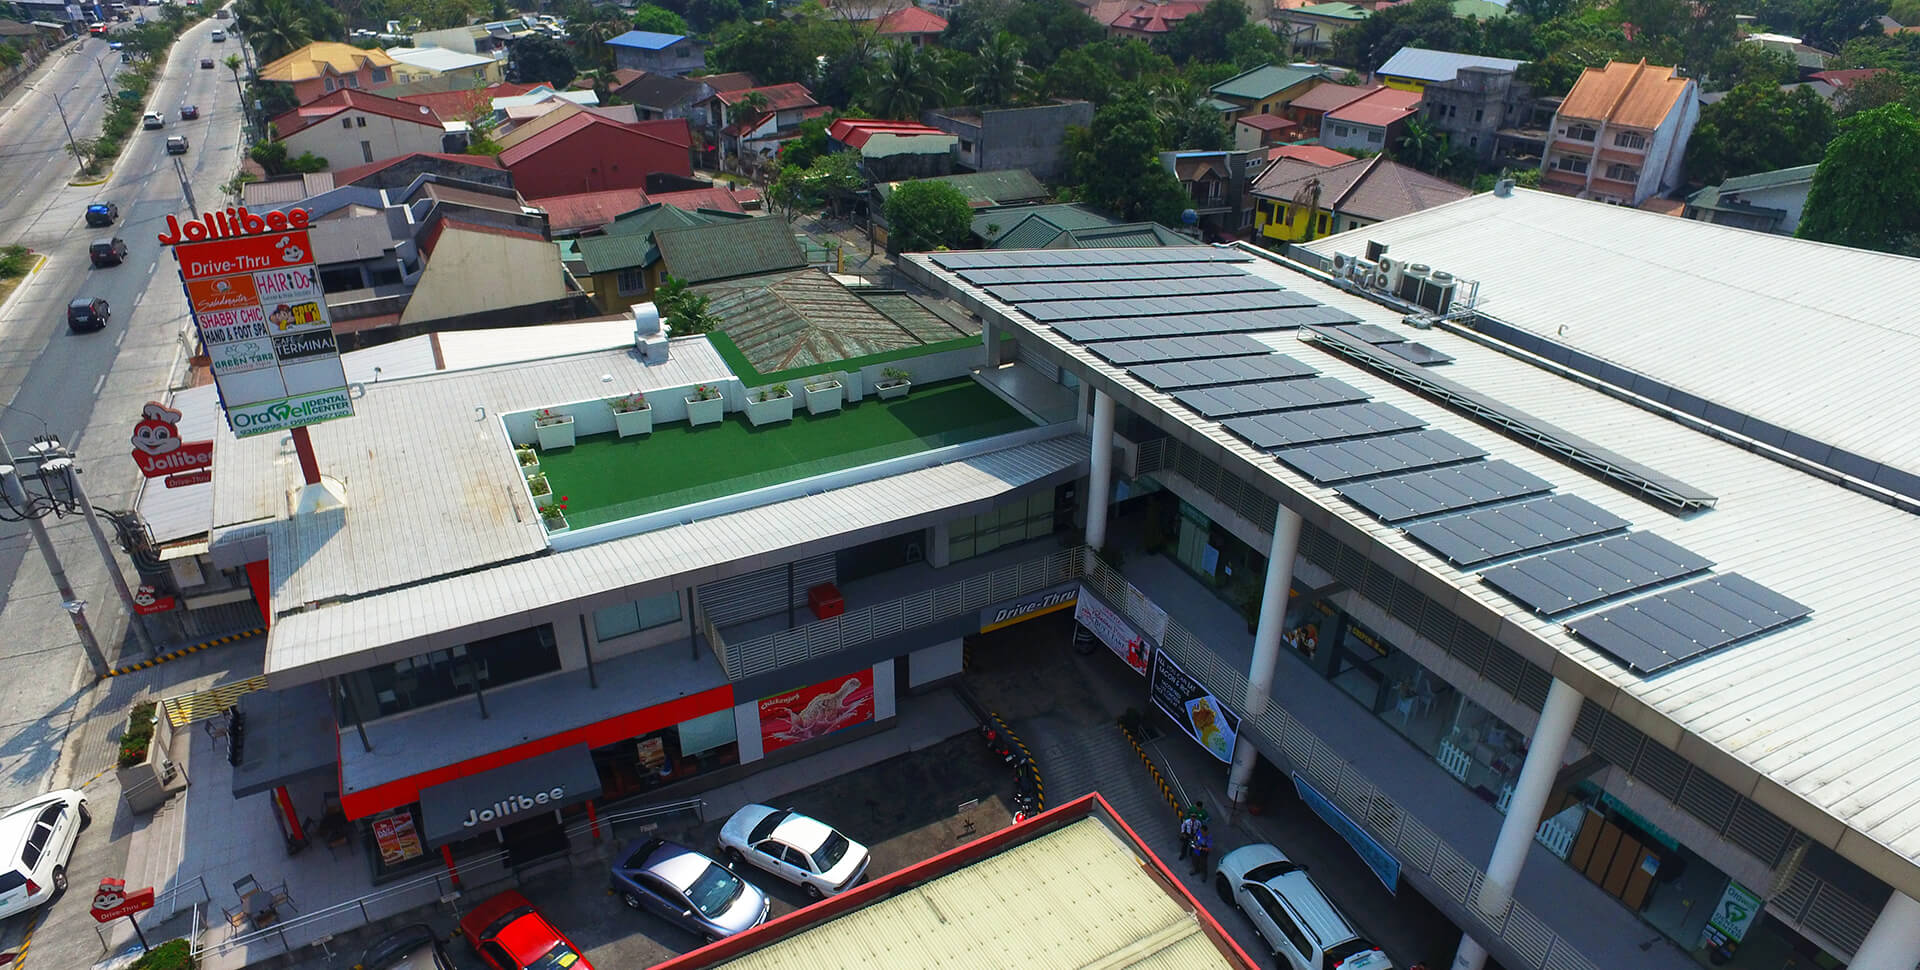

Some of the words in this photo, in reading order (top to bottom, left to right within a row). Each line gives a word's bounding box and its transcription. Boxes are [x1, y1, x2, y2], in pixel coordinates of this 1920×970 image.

[158, 207, 309, 244] Jollibee
[191, 255, 270, 276] Drive-Thru
[256, 273, 289, 294] HAIR
[200, 310, 239, 328] SHABBY
[240, 307, 263, 323] CHIC
[204, 328, 226, 344] HAND
[226, 326, 233, 340] &
[233, 324, 253, 339] FOOT
[253, 322, 268, 337] SPA
[275, 337, 336, 355] TERMINAL
[310, 394, 348, 407] DENTAL
[312, 402, 349, 414] CENTER
[994, 589, 1076, 622] Drive-Thru
[464, 787, 564, 827] Jollibee
[101, 904, 139, 920] Drive-Thru
